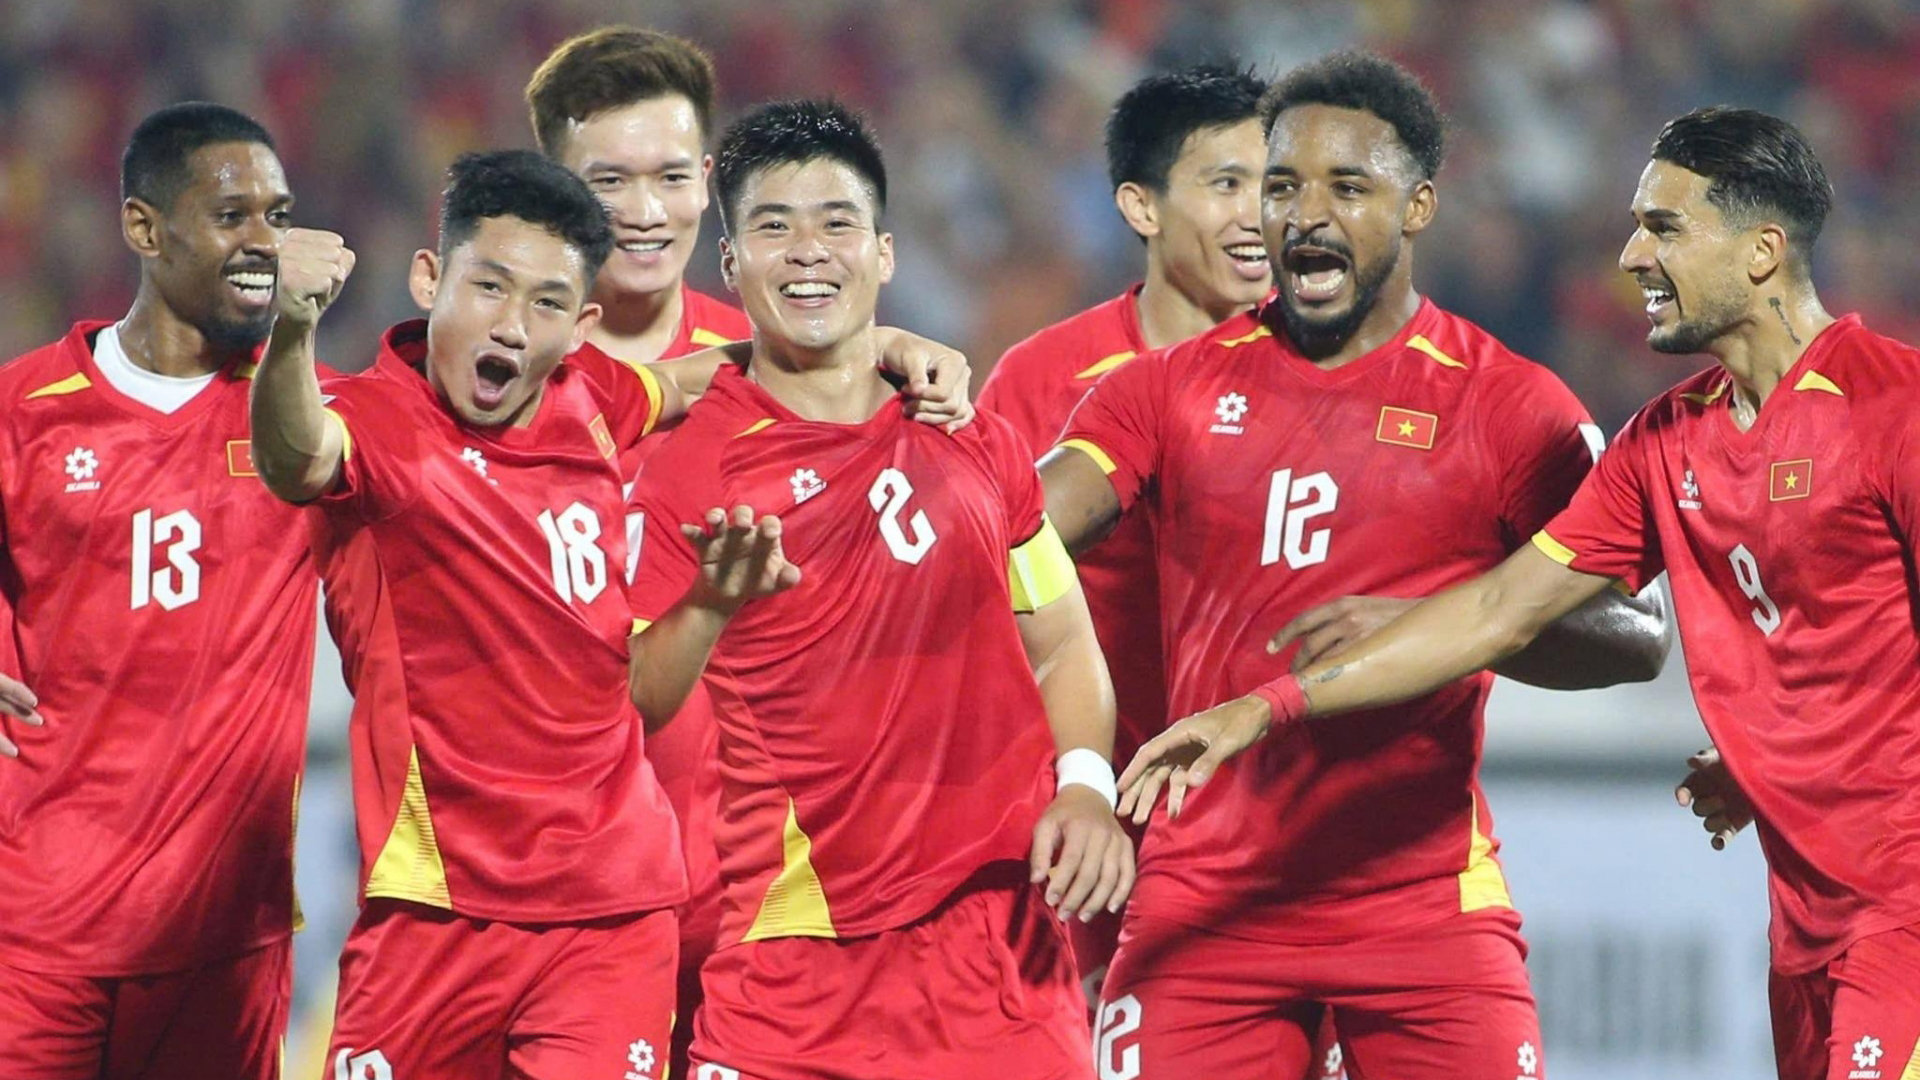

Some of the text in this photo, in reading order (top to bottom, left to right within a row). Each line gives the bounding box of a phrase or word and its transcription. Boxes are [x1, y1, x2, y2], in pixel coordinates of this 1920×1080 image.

[131, 508, 201, 611] 13
[536, 500, 608, 606] 18
[868, 467, 938, 566] 2
[1261, 468, 1339, 570] 12
[1728, 543, 1781, 638] 9
